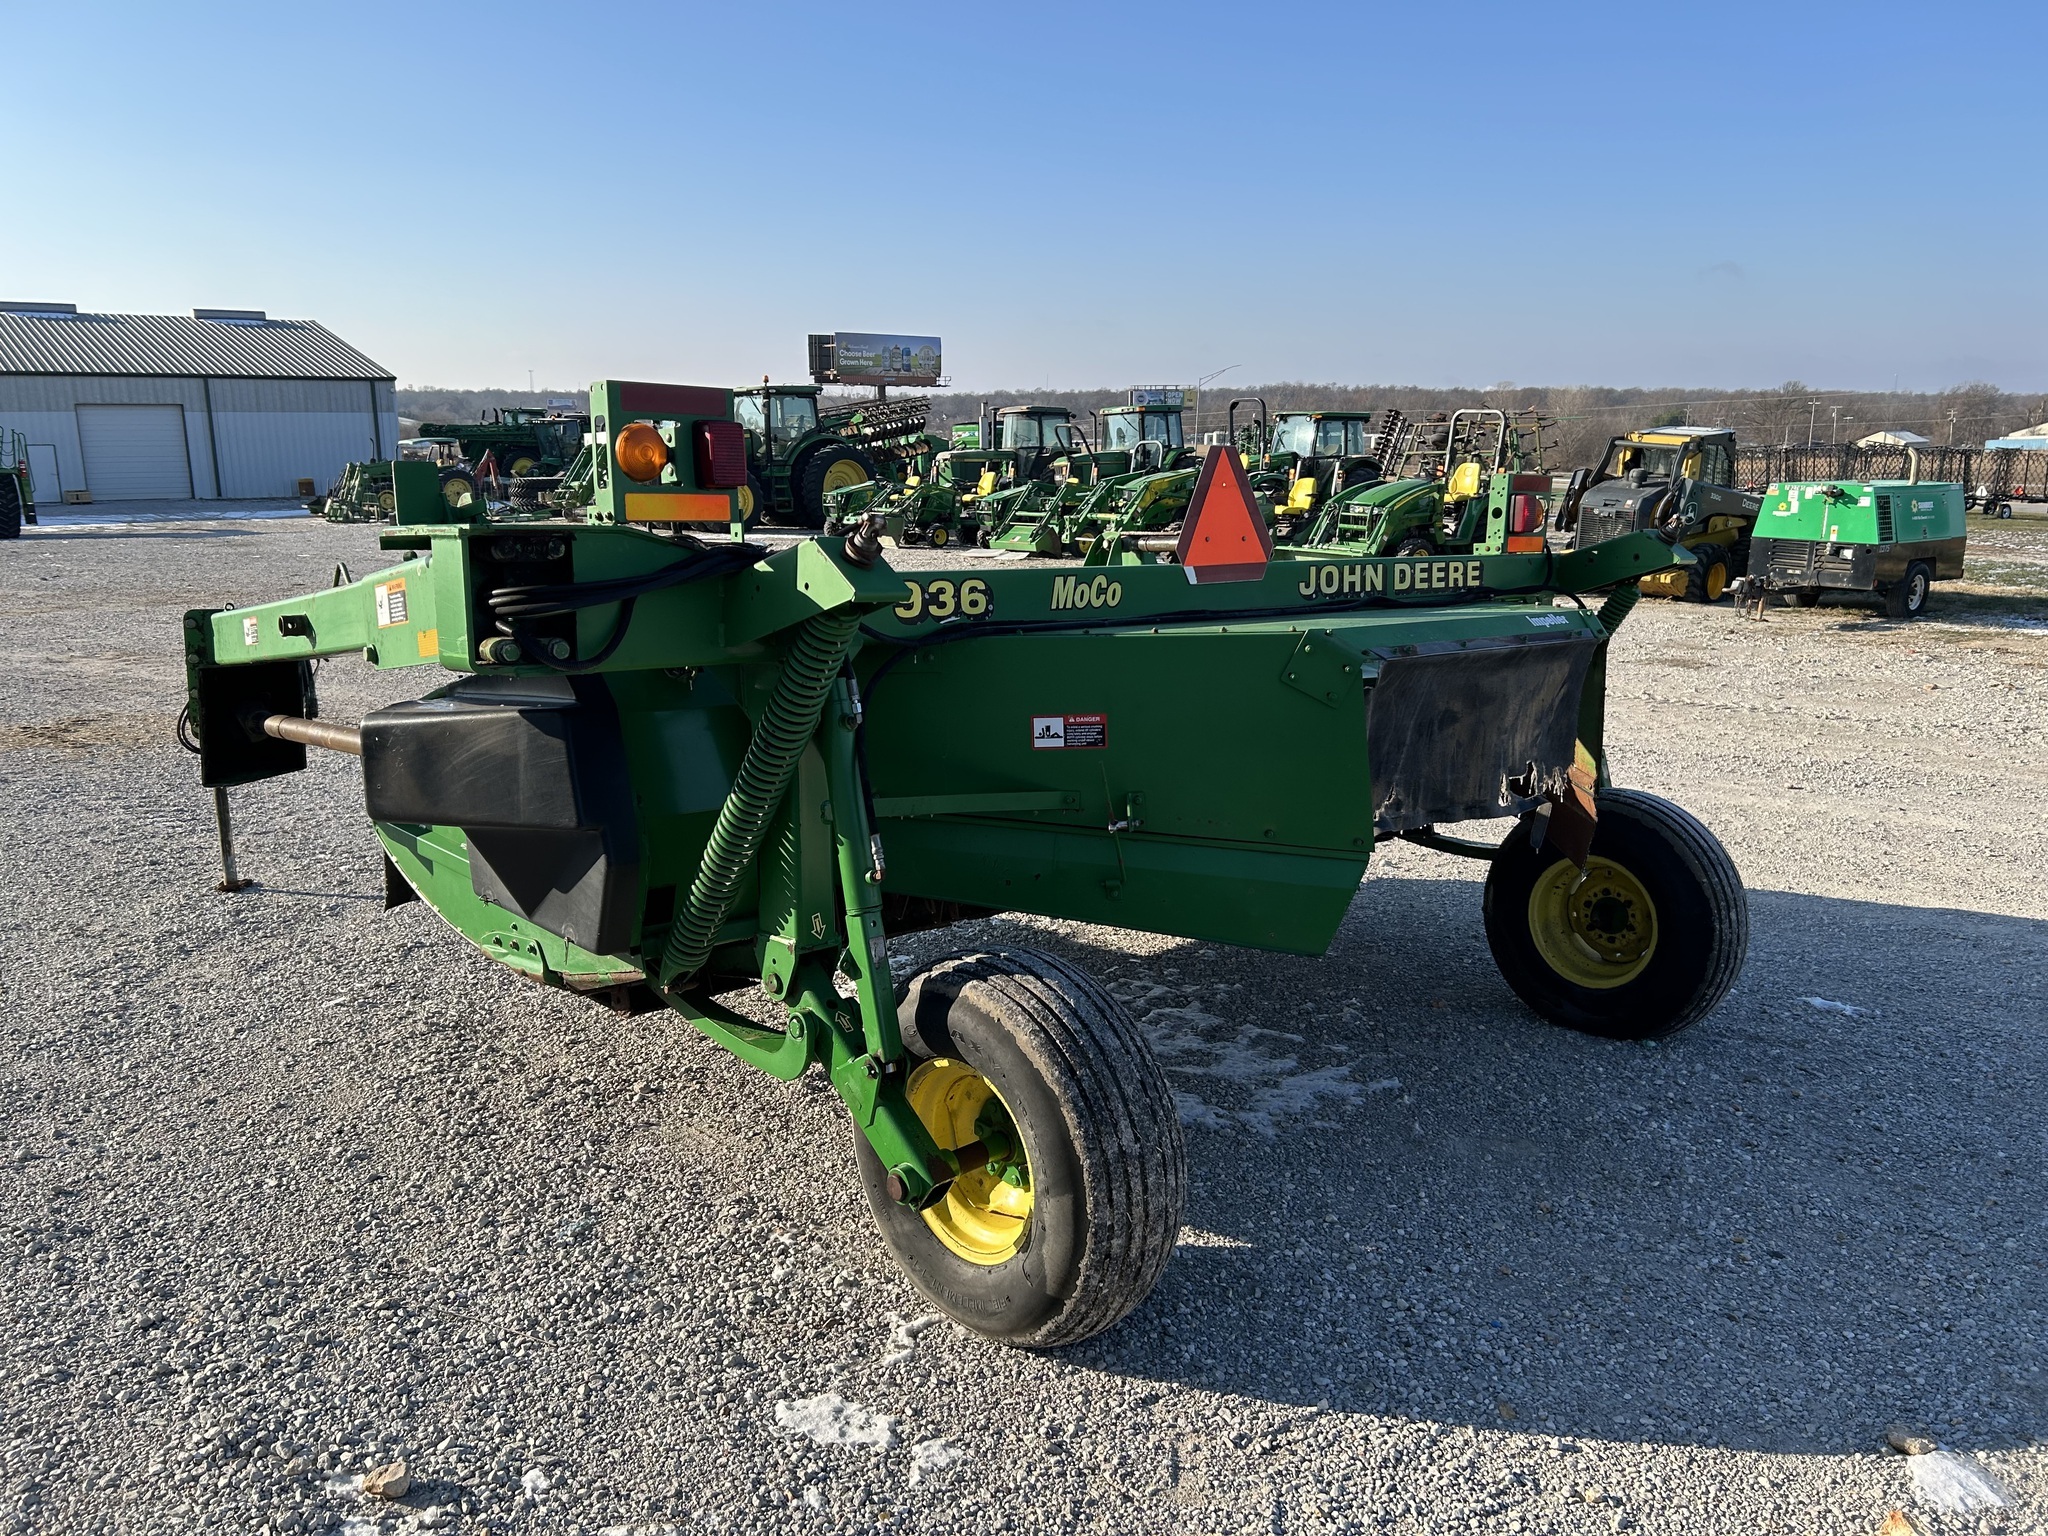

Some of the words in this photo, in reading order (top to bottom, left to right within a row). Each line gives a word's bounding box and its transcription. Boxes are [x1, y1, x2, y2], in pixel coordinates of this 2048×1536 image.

[839, 349, 862, 358] Choose
[862, 350, 876, 358] Beer
[839, 358, 860, 366] Grown
[860, 358, 873, 366] Here
[1742, 498, 1760, 511] DEERE
[1050, 573, 1122, 610] MoCo
[1299, 563, 1384, 597] JOHN
[1393, 559, 1482, 592] DEERE
[1525, 613, 1570, 628] Impeller
